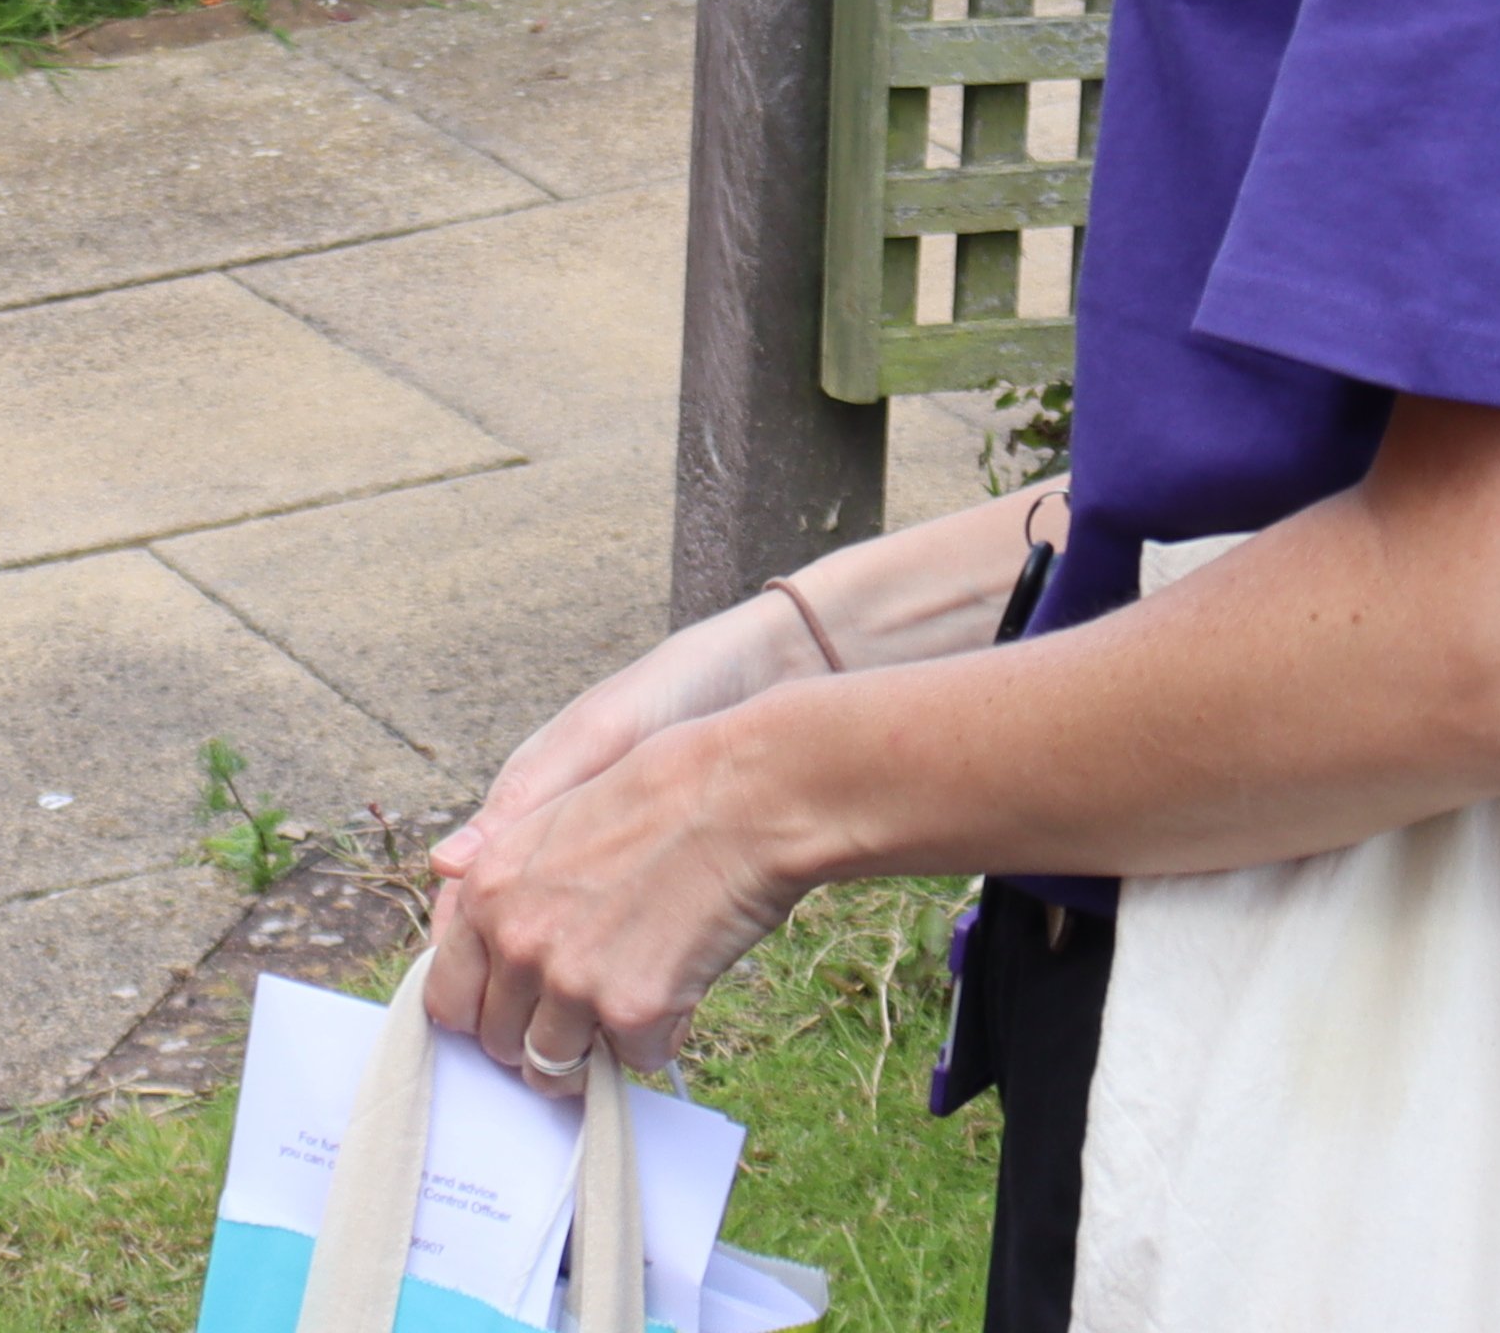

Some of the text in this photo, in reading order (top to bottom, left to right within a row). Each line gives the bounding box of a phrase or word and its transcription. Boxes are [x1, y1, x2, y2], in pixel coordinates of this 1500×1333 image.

[279, 1145, 301, 1159] you
[303, 1153, 325, 1167] can
[422, 1186, 469, 1210] Control
[471, 1200, 513, 1222] Officer
[298, 1130, 318, 1147] For
[431, 1173, 456, 1189] and
[458, 1181, 499, 1201] advice
